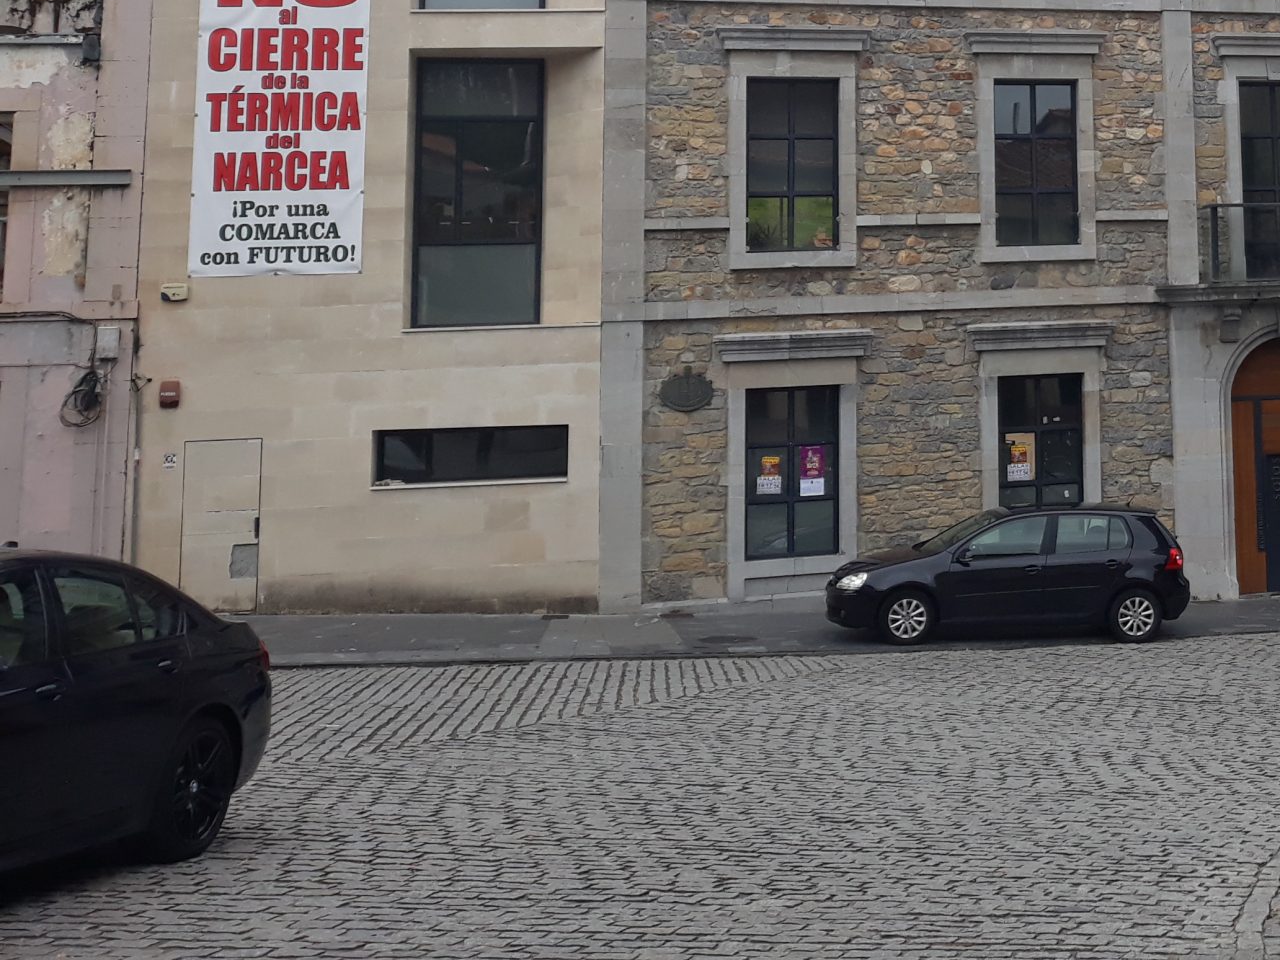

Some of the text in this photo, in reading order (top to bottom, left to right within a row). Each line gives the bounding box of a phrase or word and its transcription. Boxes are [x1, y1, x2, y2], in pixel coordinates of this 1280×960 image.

[279, 6, 297, 25] al
[207, 28, 363, 72] CIERRE
[261, 73, 309, 90] de la
[206, 85, 360, 132] TÉRMICA
[265, 133, 300, 149] del
[213, 151, 350, 192] NARCEA
[232, 201, 329, 218] ¡Por una
[218, 222, 341, 242] COMARCA
[200, 244, 356, 266] con FUTURO!
